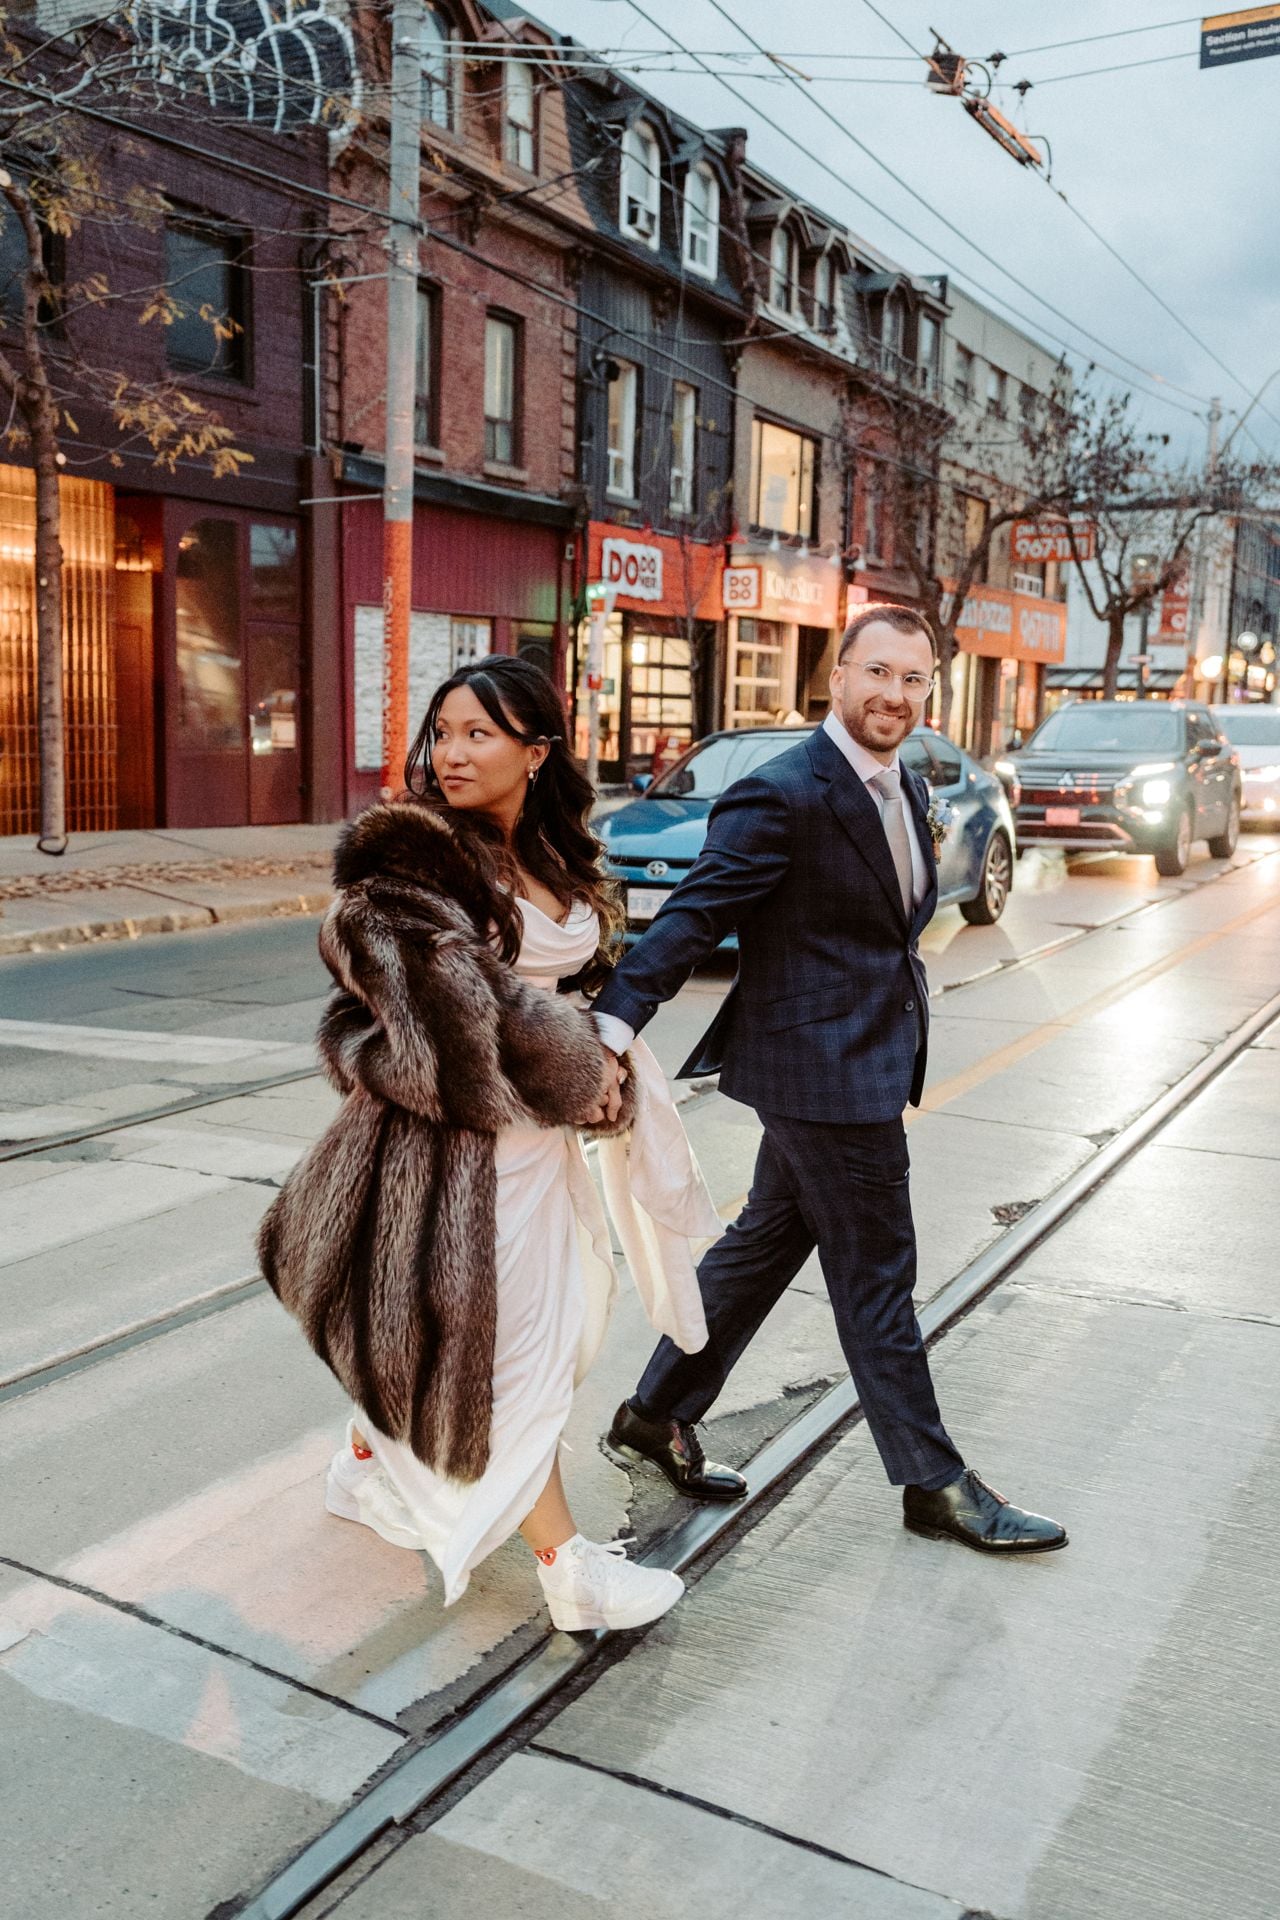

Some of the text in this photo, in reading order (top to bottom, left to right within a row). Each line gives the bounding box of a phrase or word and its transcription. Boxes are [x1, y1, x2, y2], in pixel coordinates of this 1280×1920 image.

[1206, 31, 1246, 47] Section
[609, 550, 639, 586] DO
[730, 576, 751, 587] DO
[730, 589, 751, 600] DO
